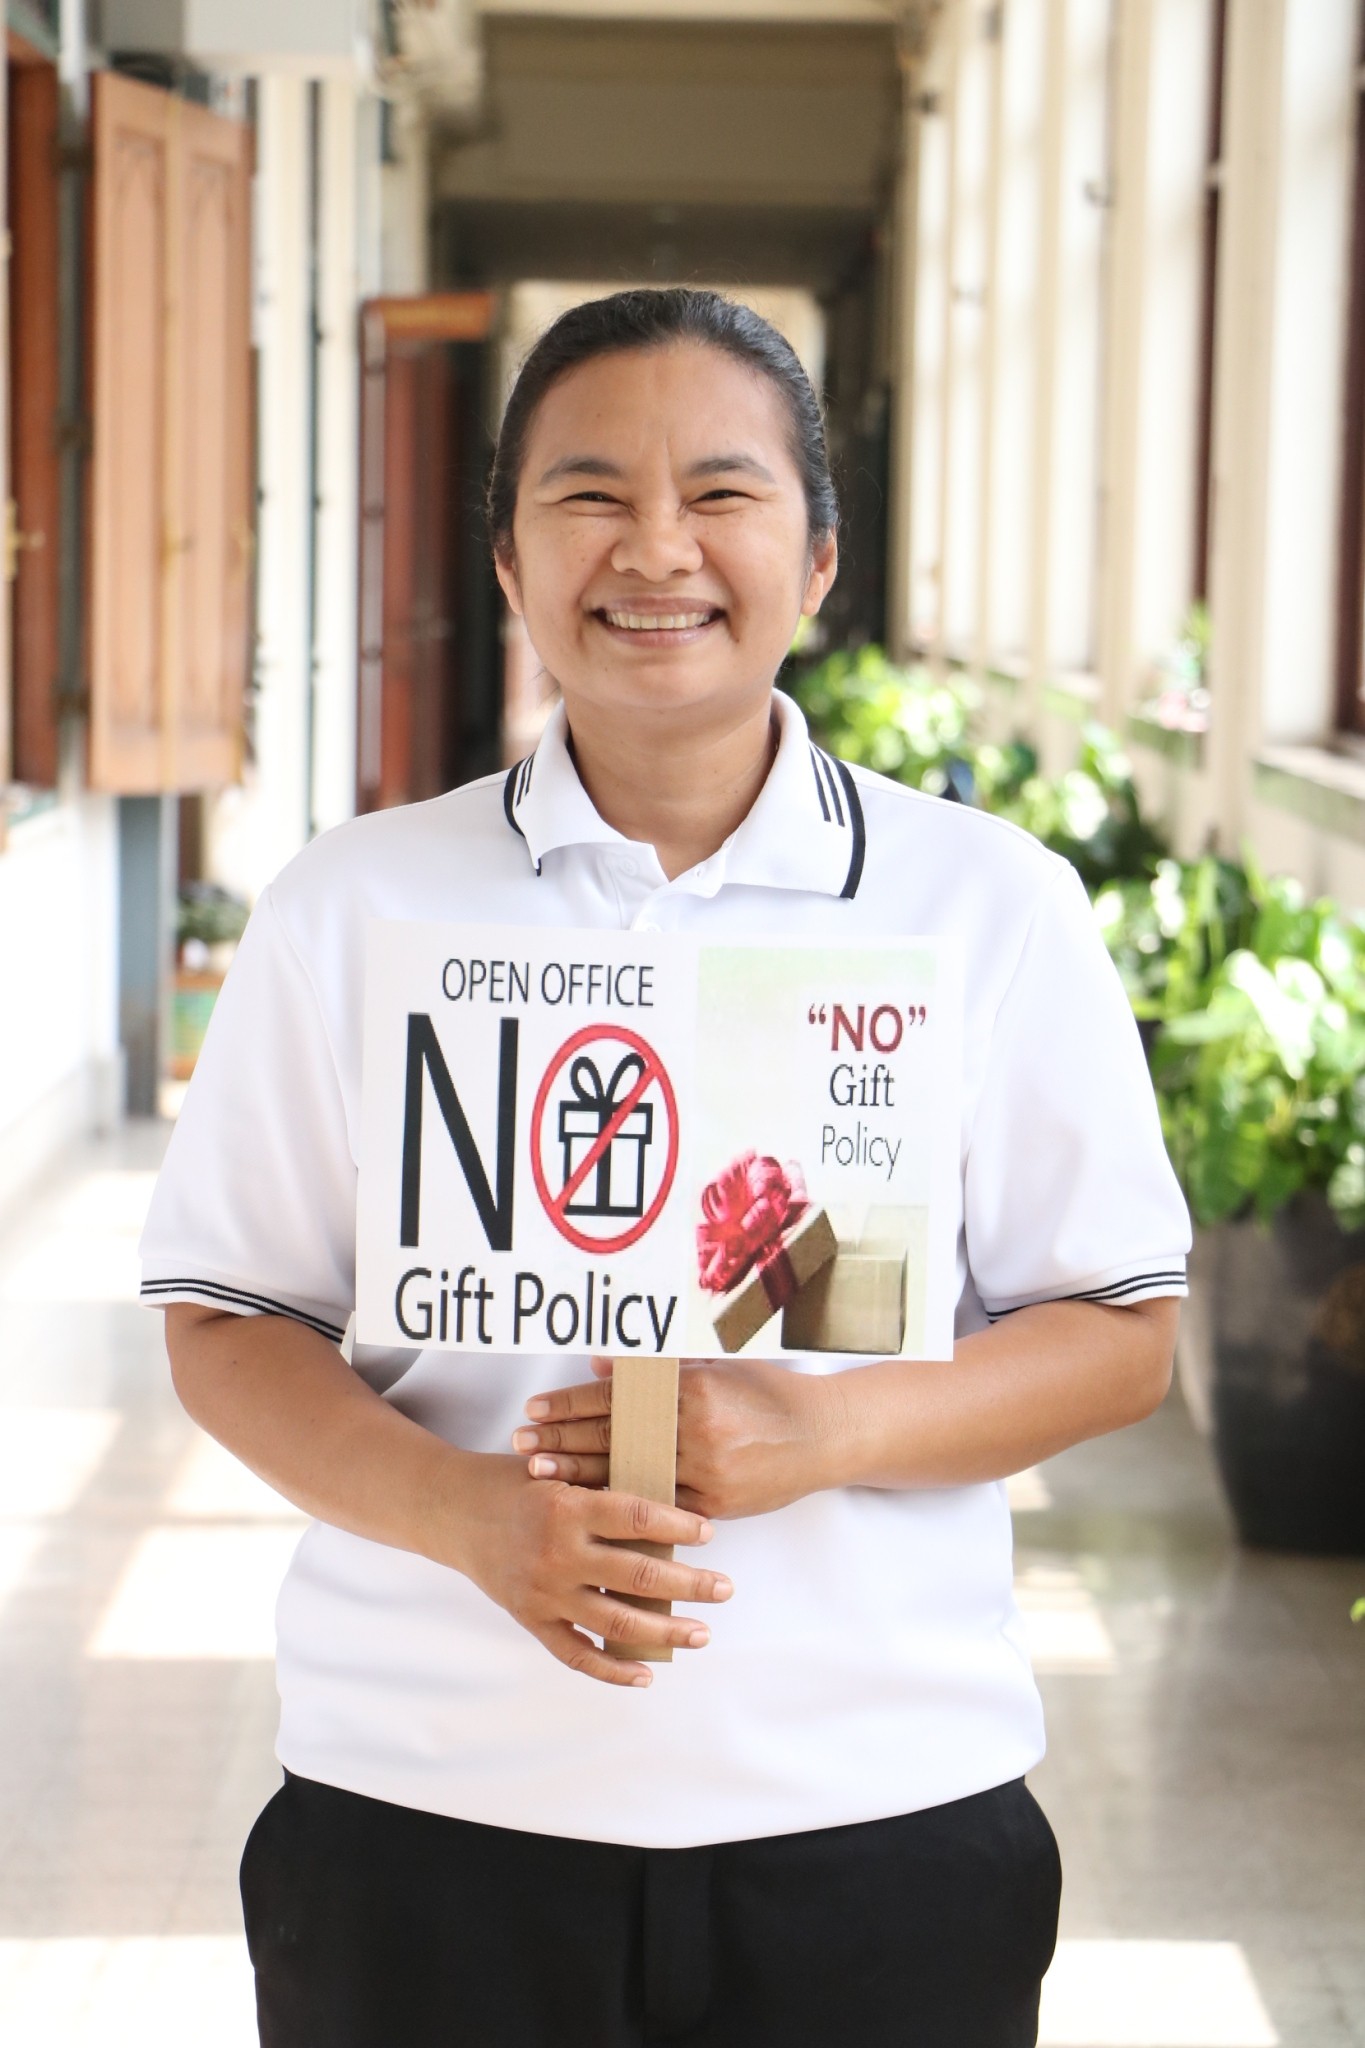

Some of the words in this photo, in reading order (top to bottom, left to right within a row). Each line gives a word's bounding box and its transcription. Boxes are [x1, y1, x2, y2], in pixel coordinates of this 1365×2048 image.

[442, 958, 530, 1003] OPEN
[541, 963, 655, 1007] OFFICE
[829, 1063, 895, 1107] Gift
[821, 1121, 902, 1181] Policy
[395, 1265, 494, 1345] Gift
[513, 1271, 678, 1353] Policy
